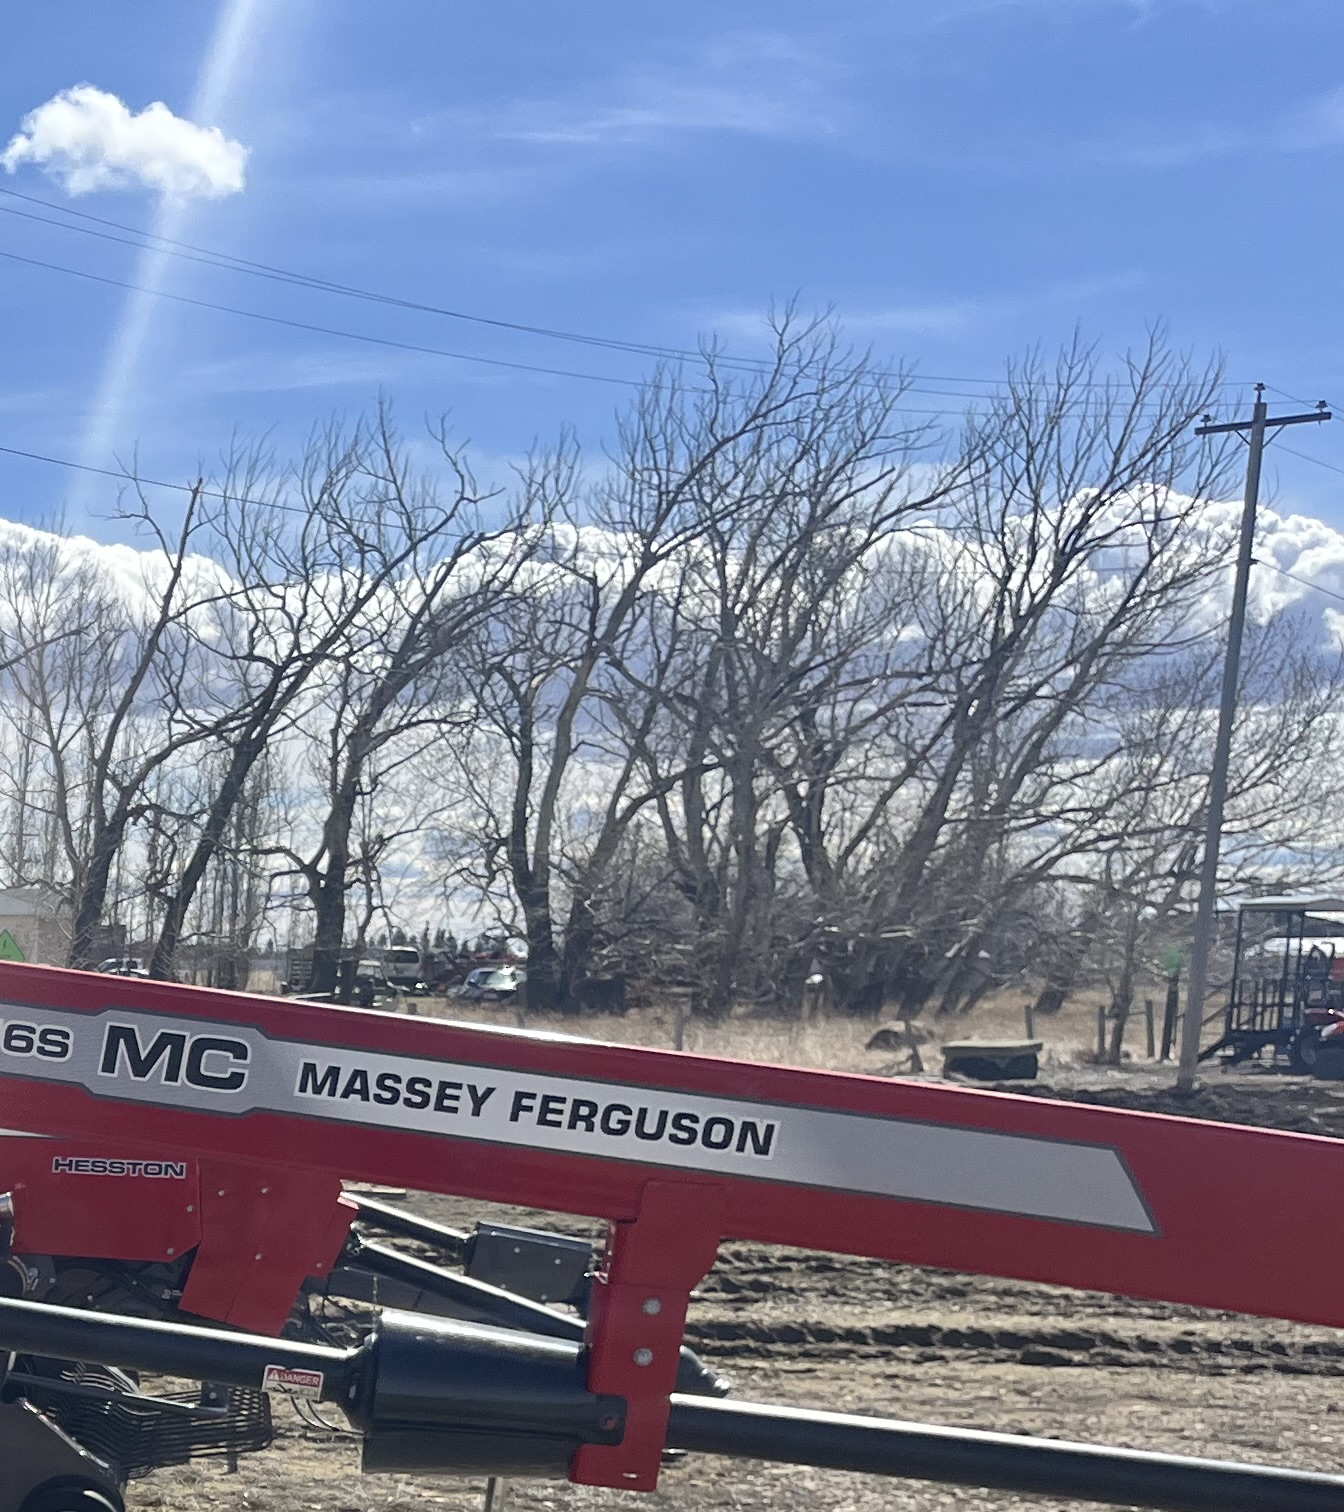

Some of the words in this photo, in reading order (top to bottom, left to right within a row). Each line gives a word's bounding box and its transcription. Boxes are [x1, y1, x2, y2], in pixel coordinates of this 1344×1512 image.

[99, 1023, 250, 1091] MC
[297, 1062, 497, 1118] MASSEY
[508, 1090, 776, 1157] FERGUSON
[53, 1158, 186, 1178] HESSTON
[280, 1371, 320, 1386] DANGER
